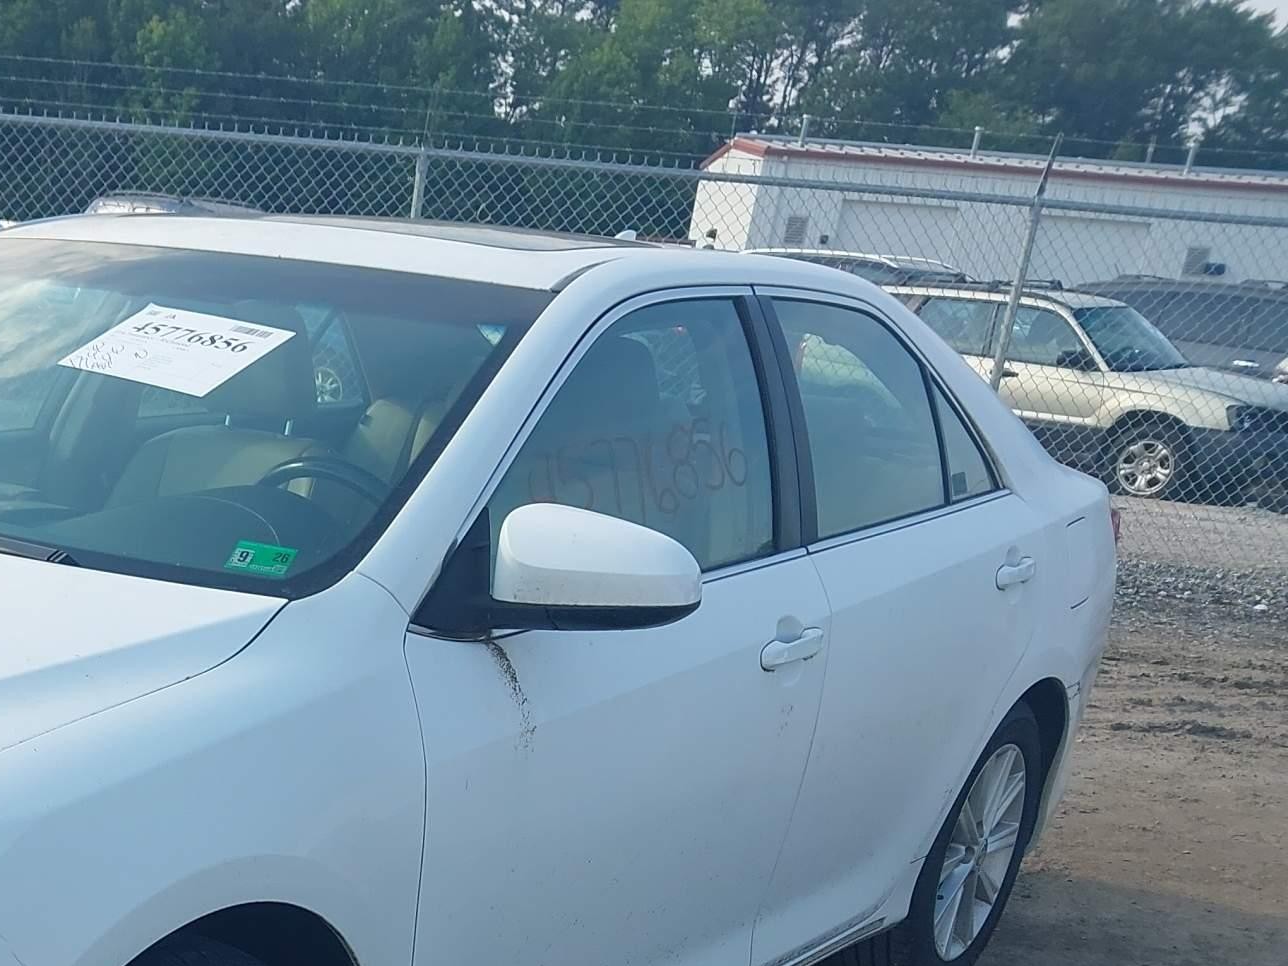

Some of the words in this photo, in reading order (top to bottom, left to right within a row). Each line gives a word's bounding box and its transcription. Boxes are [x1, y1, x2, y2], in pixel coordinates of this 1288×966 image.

[132, 322, 254, 352] 45776856
[237, 550, 250, 562] 9
[273, 552, 290, 563] 26
